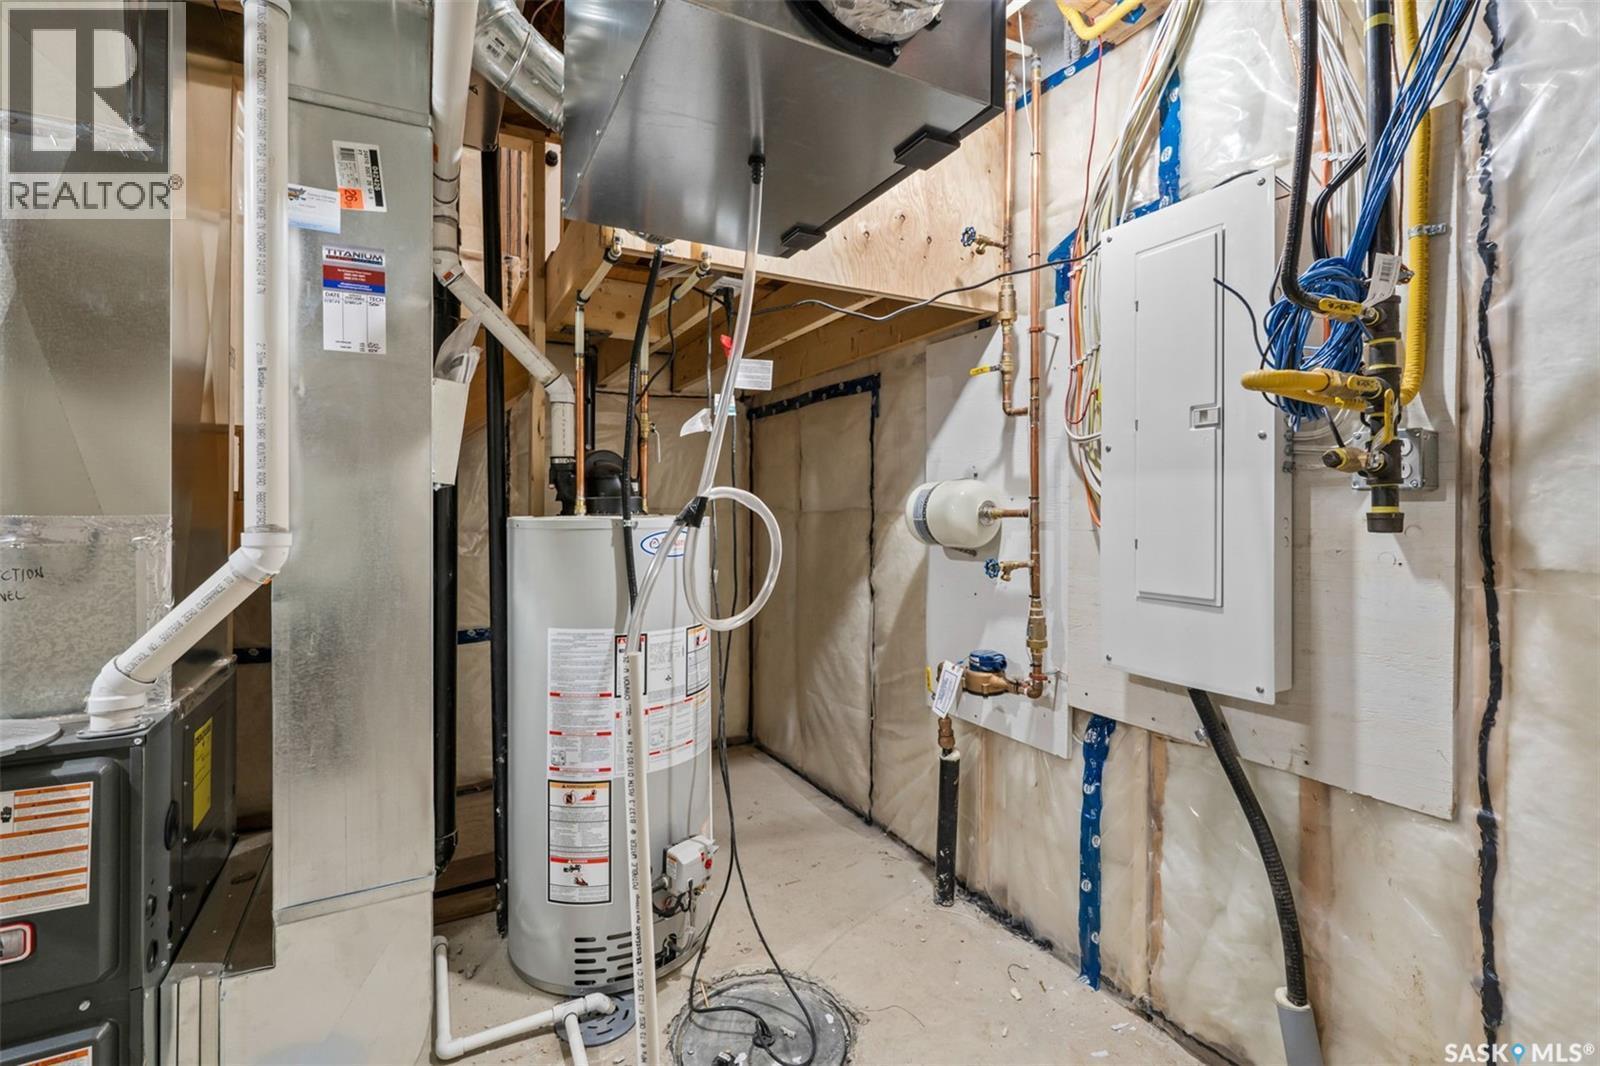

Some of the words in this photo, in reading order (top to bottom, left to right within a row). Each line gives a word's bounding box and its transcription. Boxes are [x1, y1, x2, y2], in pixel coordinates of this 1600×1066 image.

[325, 248, 383, 261] TITANIUM
[627, 780, 635, 797] ASTM
[628, 799, 636, 824] B137.3
